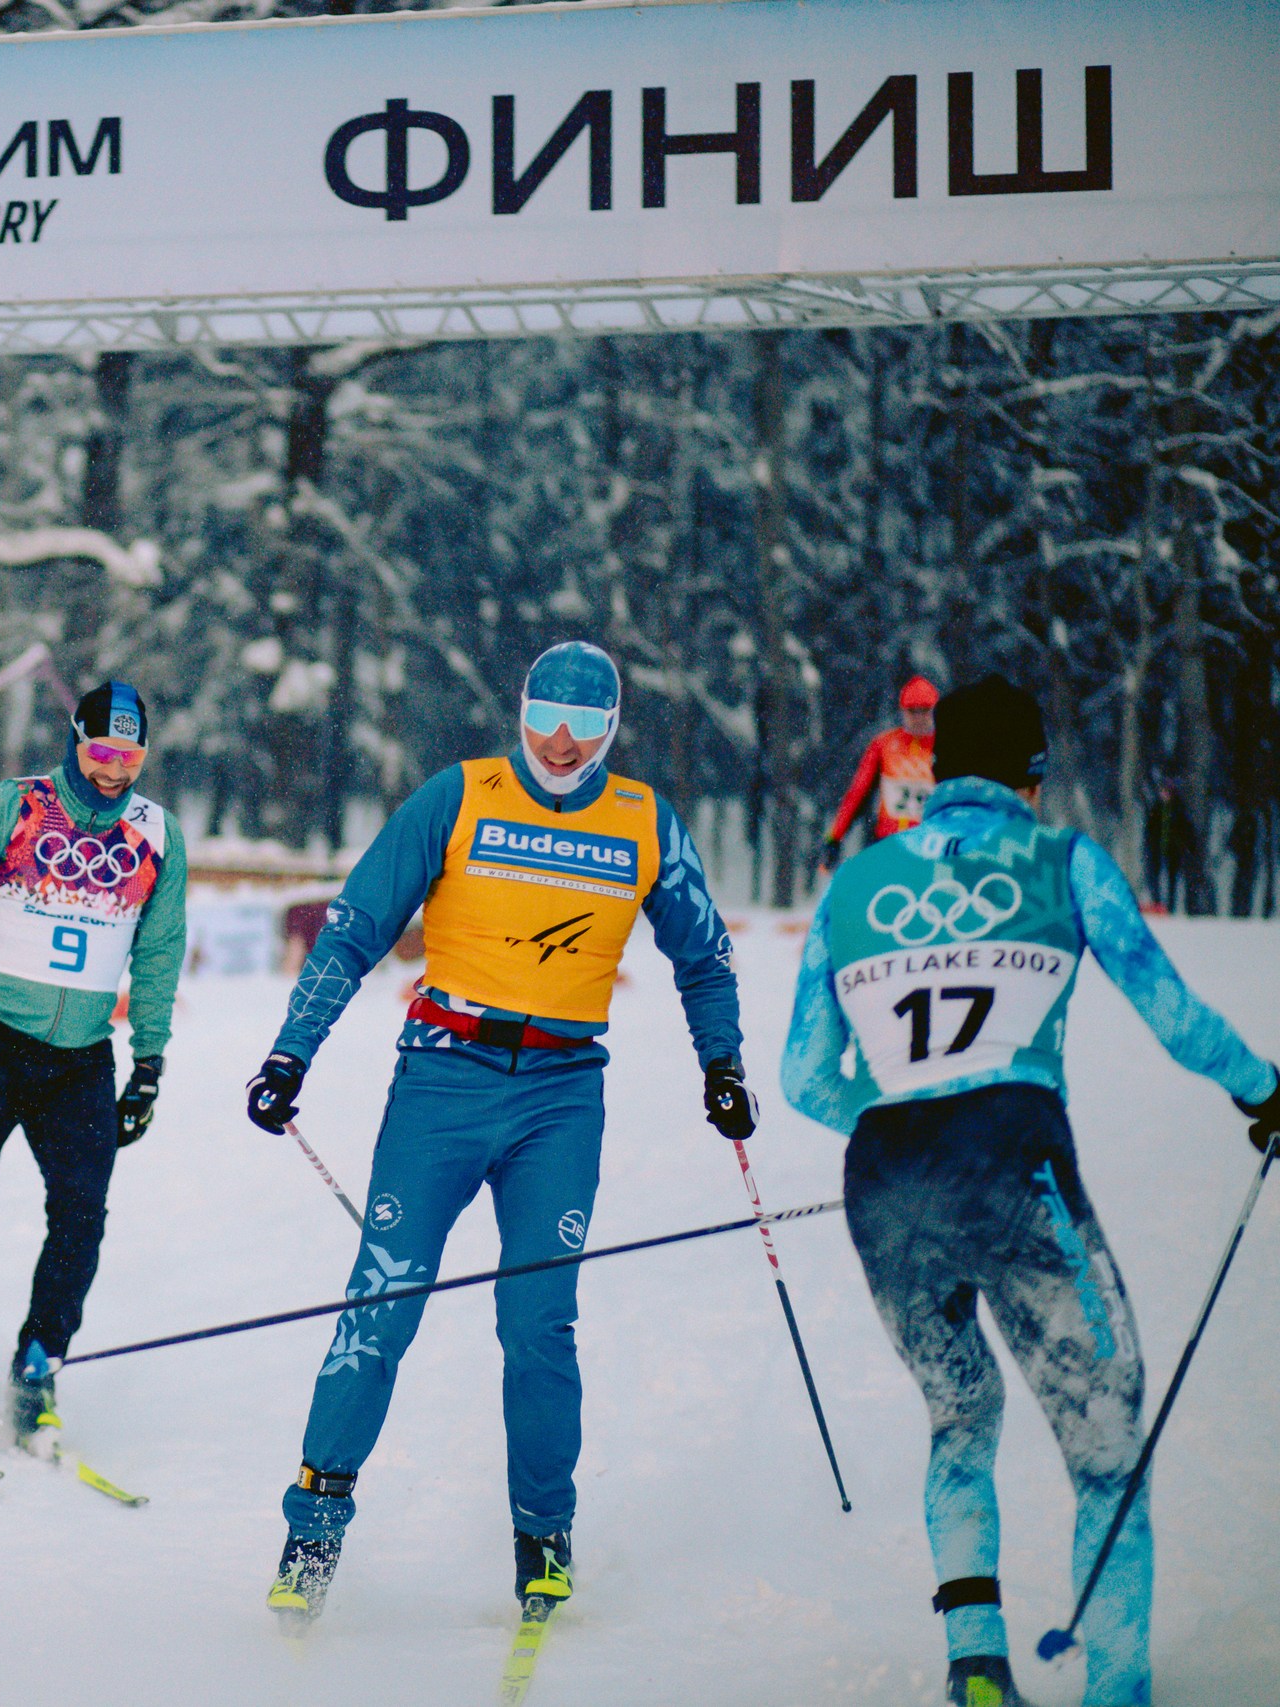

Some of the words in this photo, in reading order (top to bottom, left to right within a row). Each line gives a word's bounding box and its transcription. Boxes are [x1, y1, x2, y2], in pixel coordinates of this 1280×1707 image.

[323, 64, 1114, 221] ФИНИШ
[479, 824, 632, 867] Buderus
[488, 869, 524, 880] WORLD
[530, 875, 549, 884] CUP
[554, 879, 587, 890] CROSS
[592, 885, 633, 898] COUNTRY
[49, 925, 88, 973] 9
[841, 958, 896, 995] SALT
[905, 948, 980, 974] LAKE
[991, 947, 1062, 977] 2002
[892, 985, 996, 1064] 17
